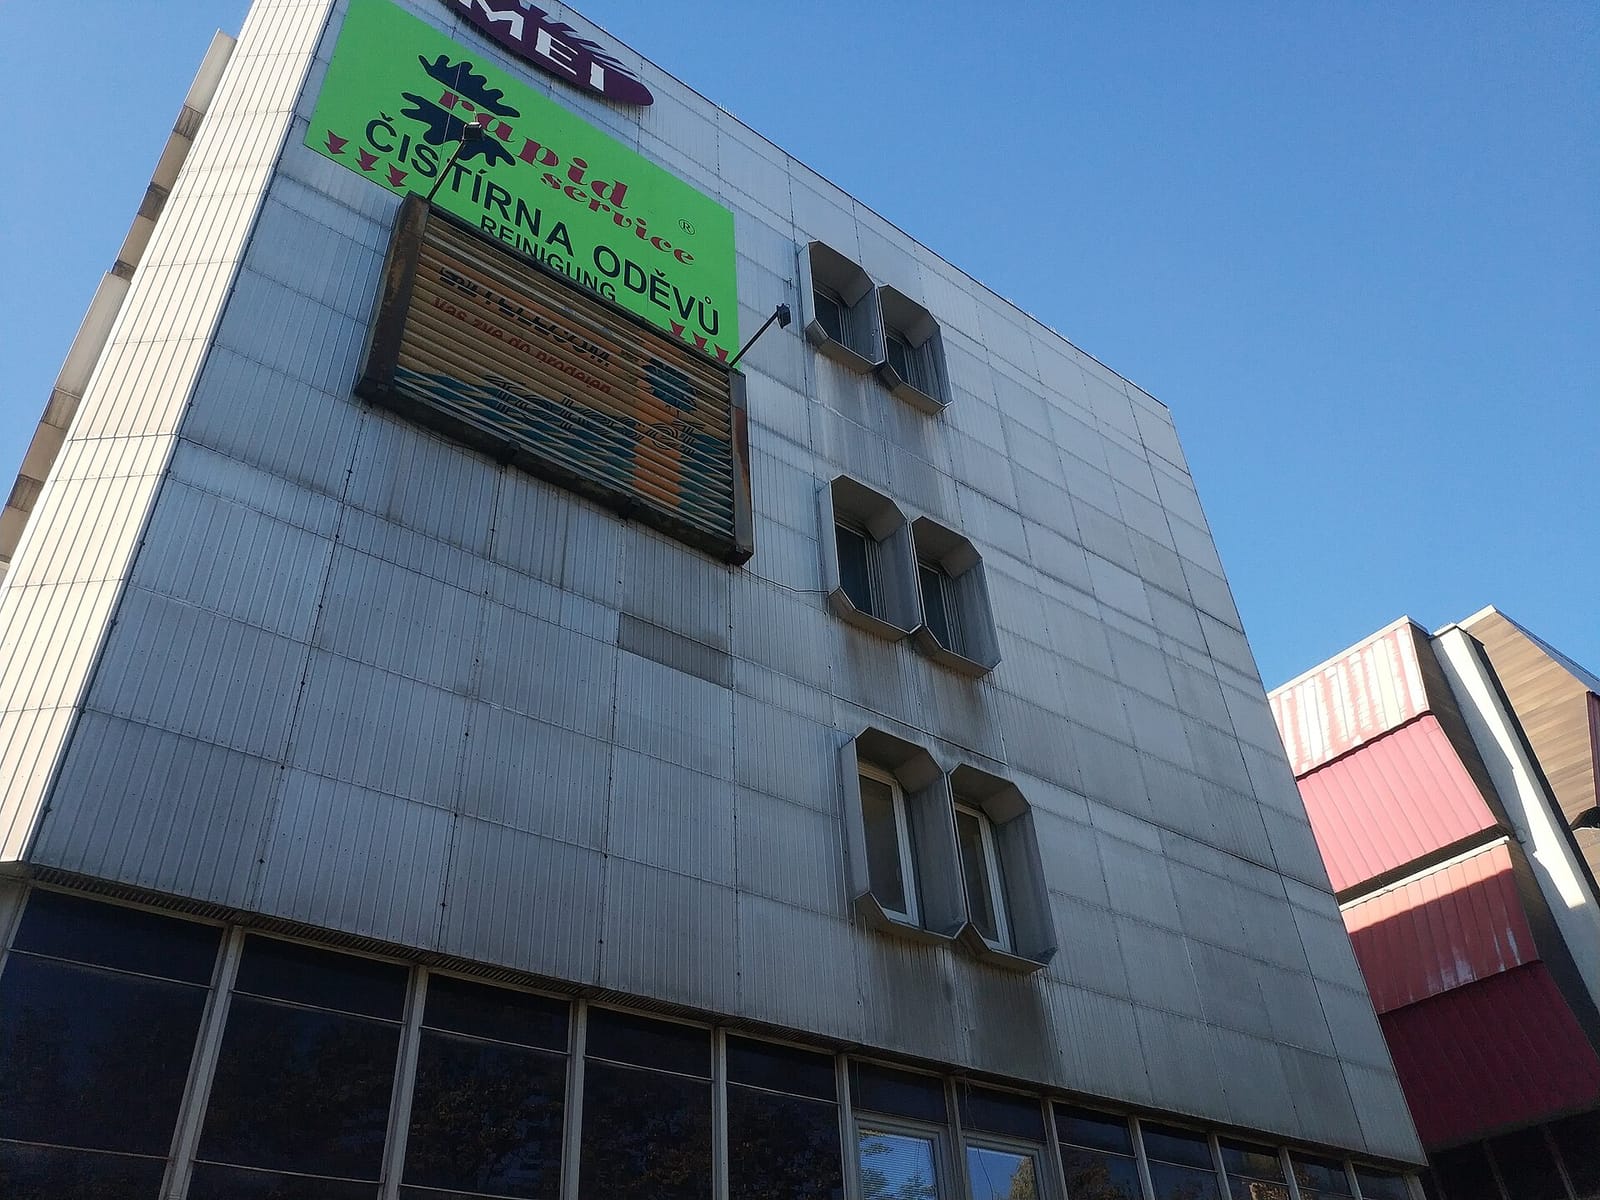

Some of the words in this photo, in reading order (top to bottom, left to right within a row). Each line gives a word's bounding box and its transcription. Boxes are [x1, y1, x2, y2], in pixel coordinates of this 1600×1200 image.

[438, 88, 628, 209] rapid
[365, 110, 575, 258] ČISTÍRNA
[593, 245, 719, 336] ODĚVŮ
[480, 214, 616, 303] REINIGUNG
[540, 172, 695, 265] service
